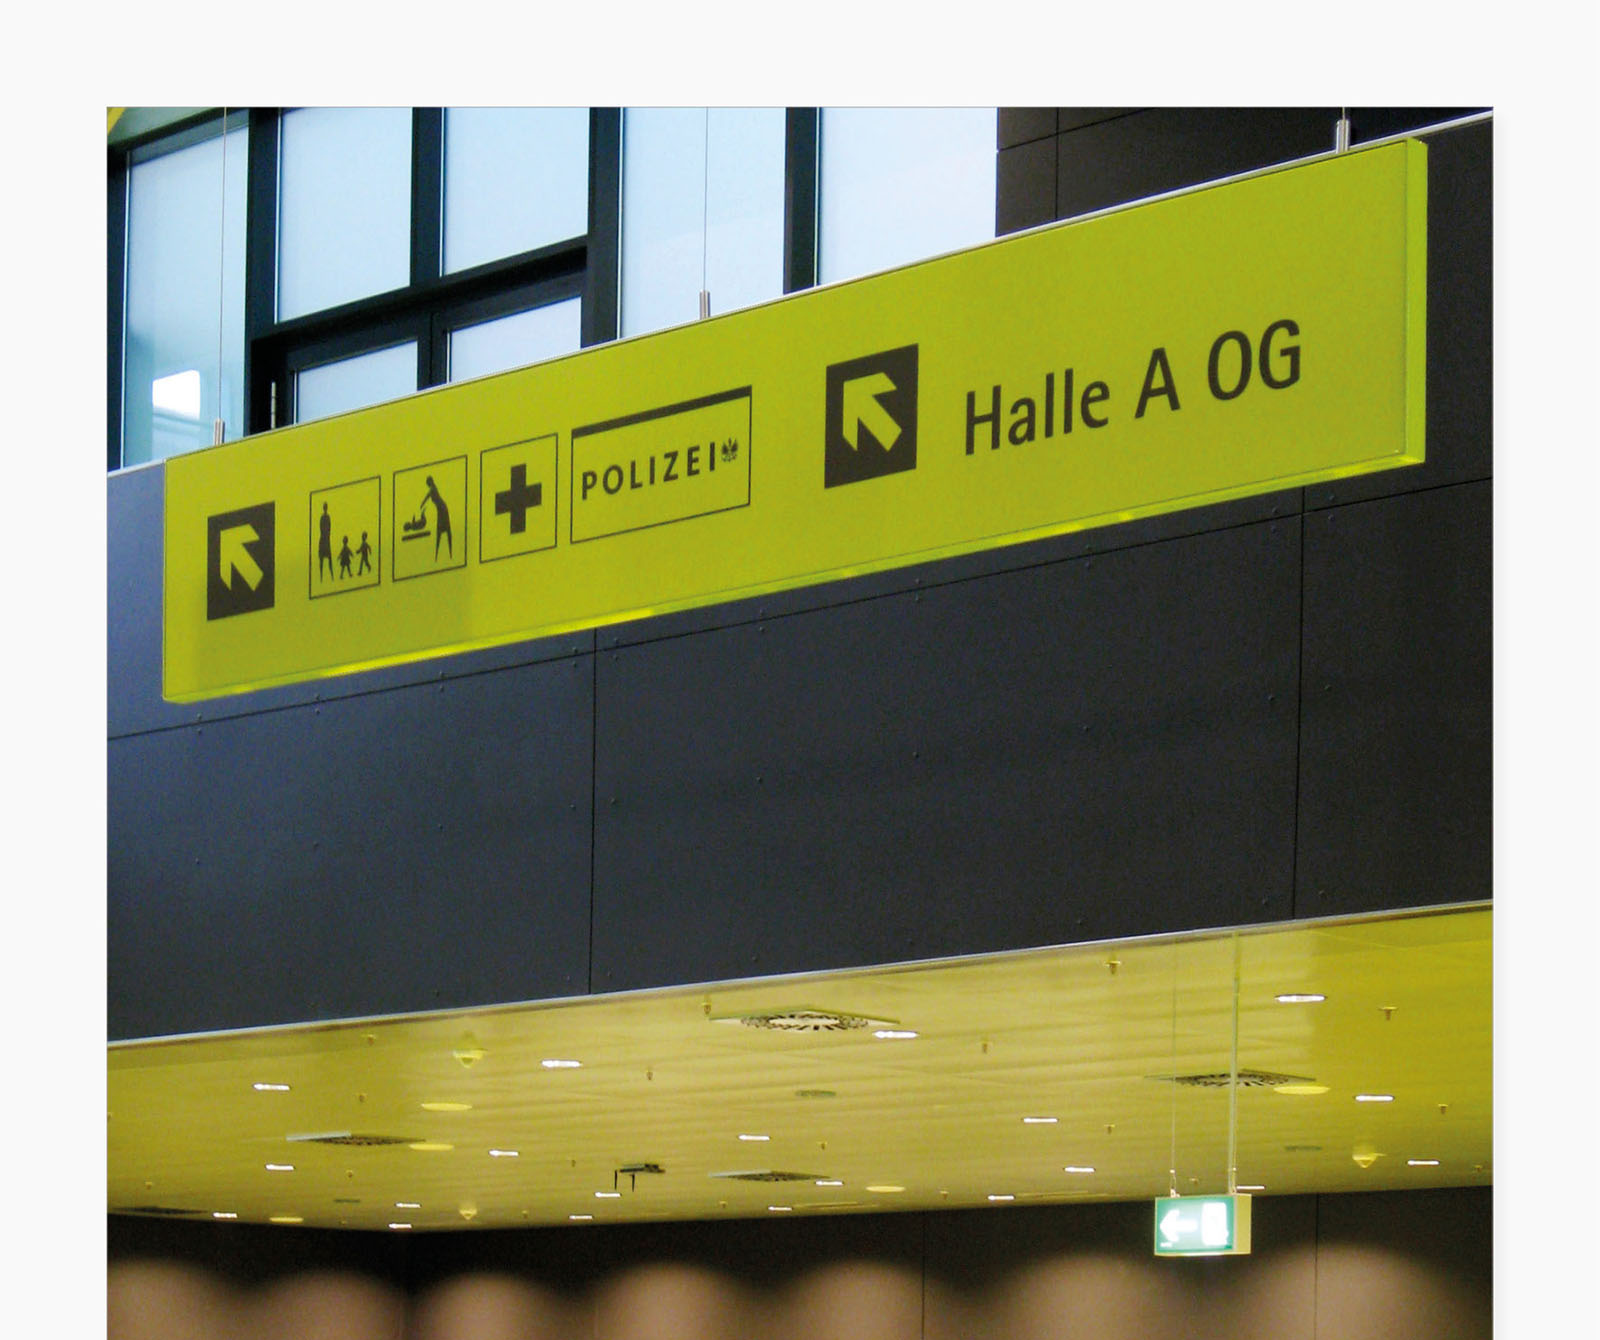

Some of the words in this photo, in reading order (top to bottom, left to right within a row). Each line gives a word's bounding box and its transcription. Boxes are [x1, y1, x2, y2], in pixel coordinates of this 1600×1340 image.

[965, 368, 1110, 455] Halle
[1134, 347, 1181, 419] A
[1206, 319, 1301, 401] OG
[582, 441, 716, 501] POLIZEI
